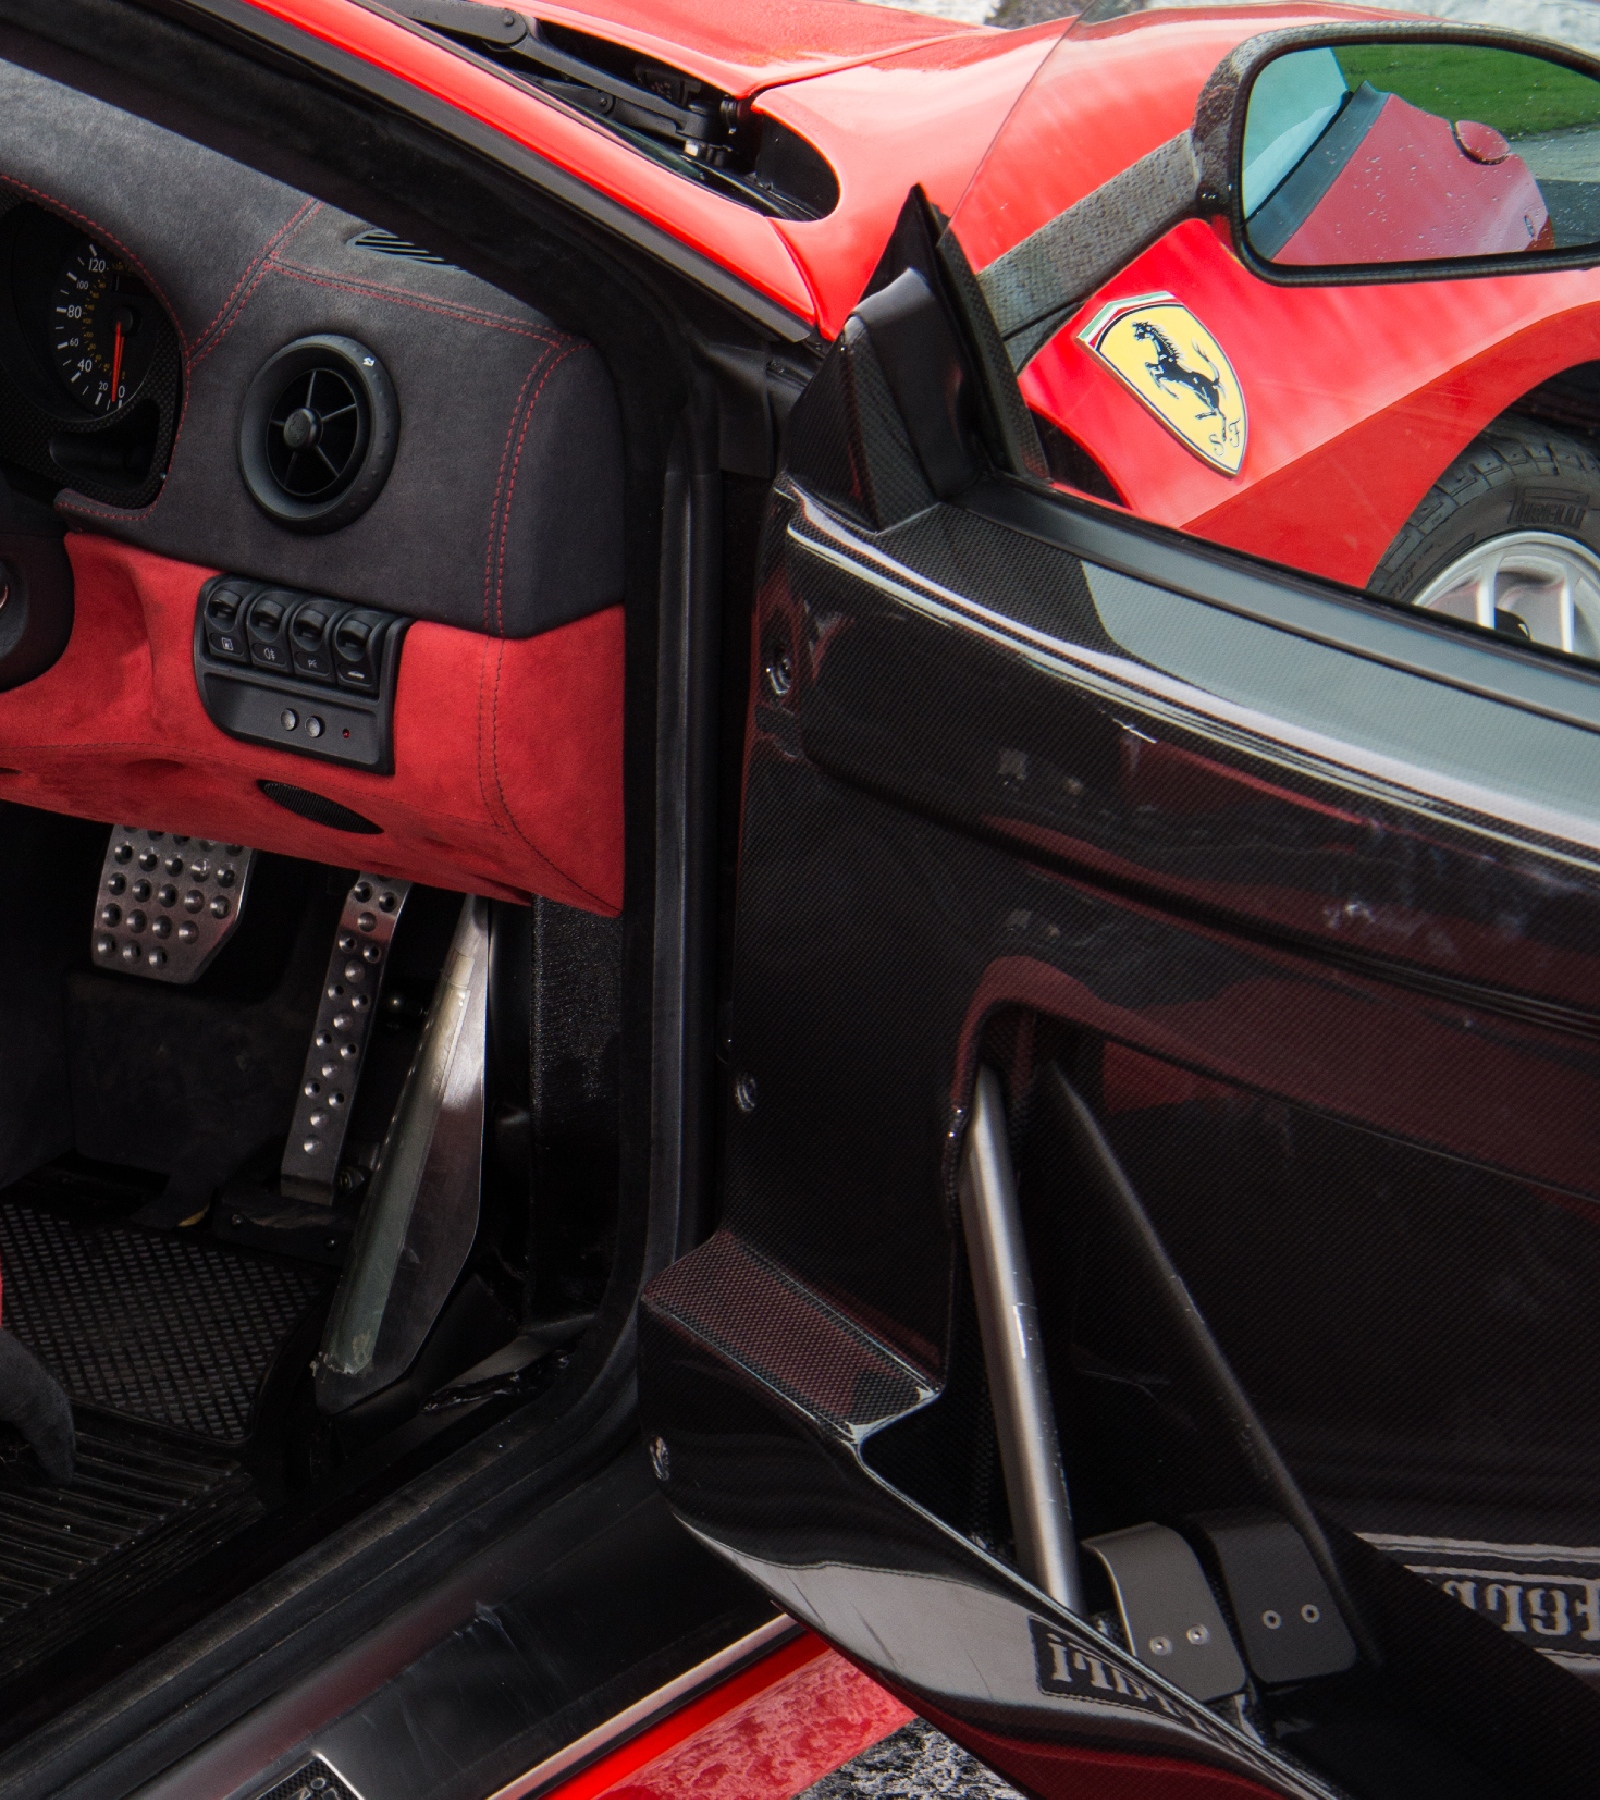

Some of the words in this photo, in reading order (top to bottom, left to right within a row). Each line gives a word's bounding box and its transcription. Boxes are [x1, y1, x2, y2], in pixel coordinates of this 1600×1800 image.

[88, 259, 106, 273] 120
[68, 305, 82, 319] 80
[70, 338, 79, 347] 60
[78, 358, 92, 373] 40
[98, 382, 109, 391] 20
[118, 385, 126, 399] 0
[1507, 486, 1589, 529] PIRELLI
